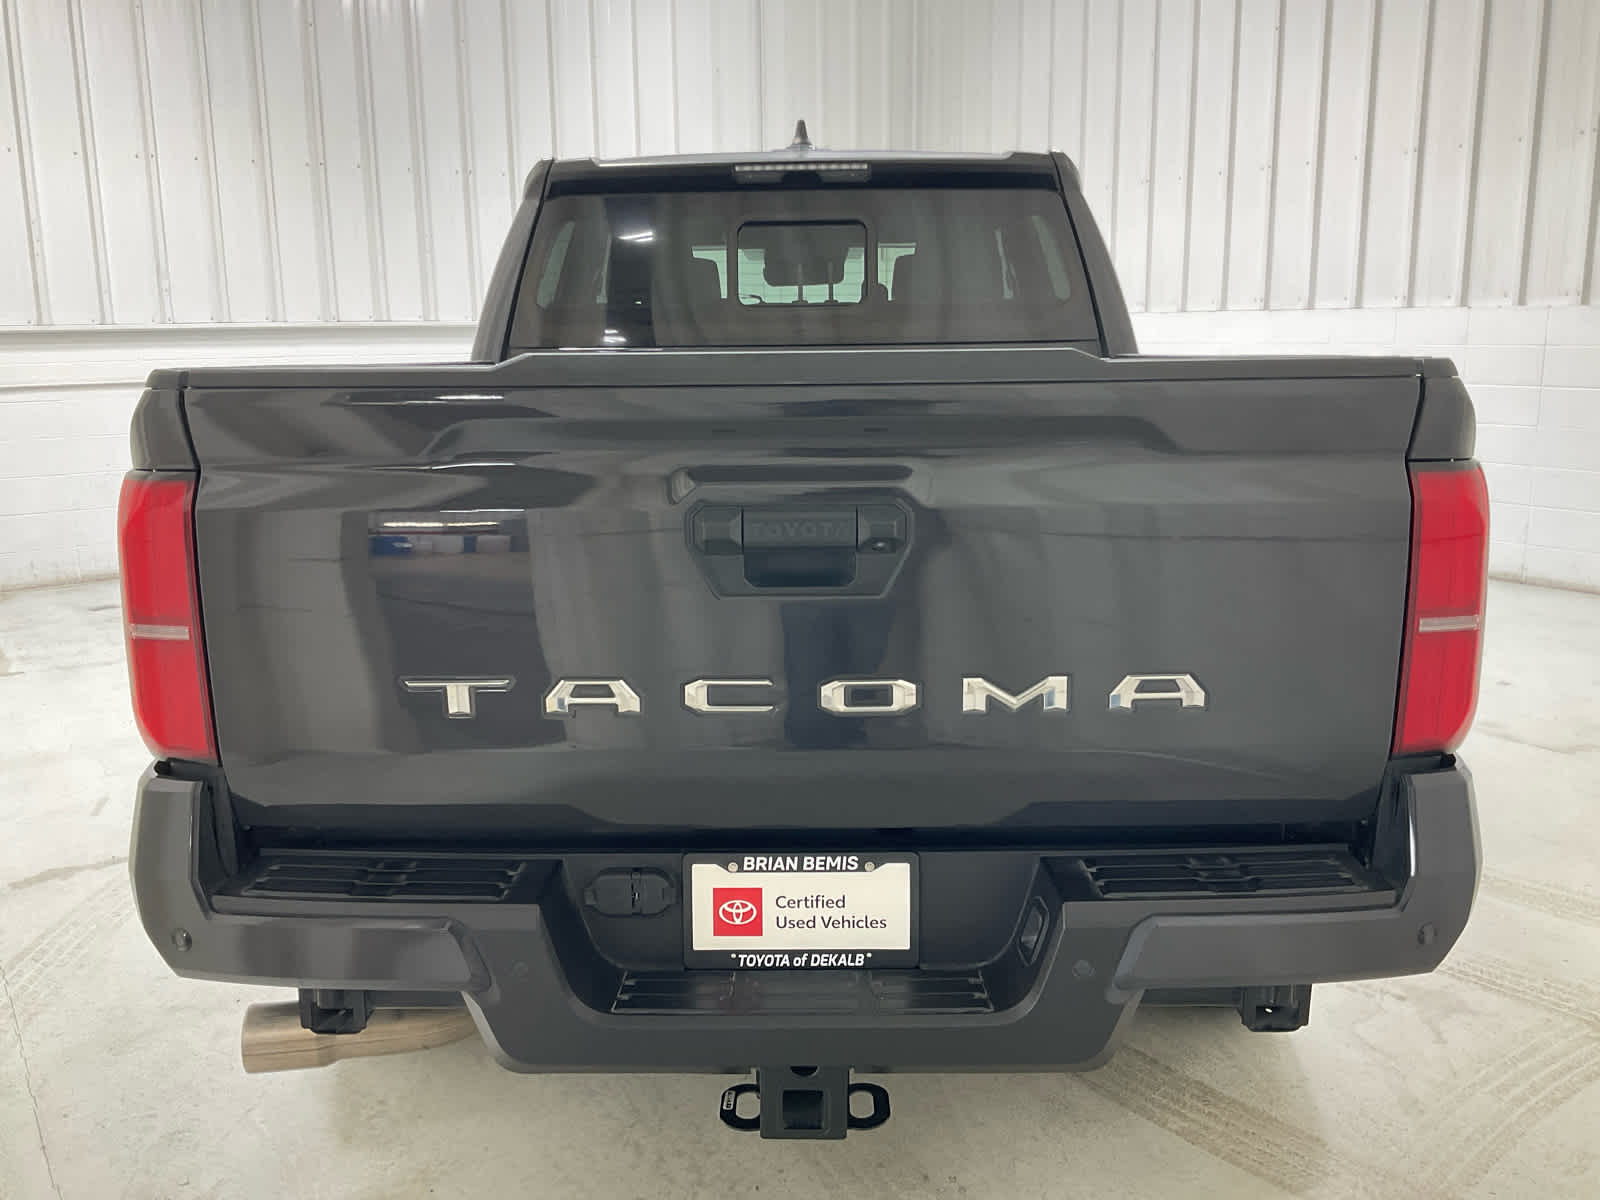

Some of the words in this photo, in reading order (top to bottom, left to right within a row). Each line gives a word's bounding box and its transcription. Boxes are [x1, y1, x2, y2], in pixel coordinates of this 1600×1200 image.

[403, 673, 1206, 718] TACOMA
[743, 856, 798, 871] BRIAN
[802, 856, 859, 871] BEMIS
[775, 895, 846, 909] Certified
[775, 915, 816, 929] Used
[821, 915, 887, 929] Vehicles
[738, 954, 790, 967] TOYOTA
[793, 953, 808, 966] of
[810, 953, 865, 967] DEKALB
